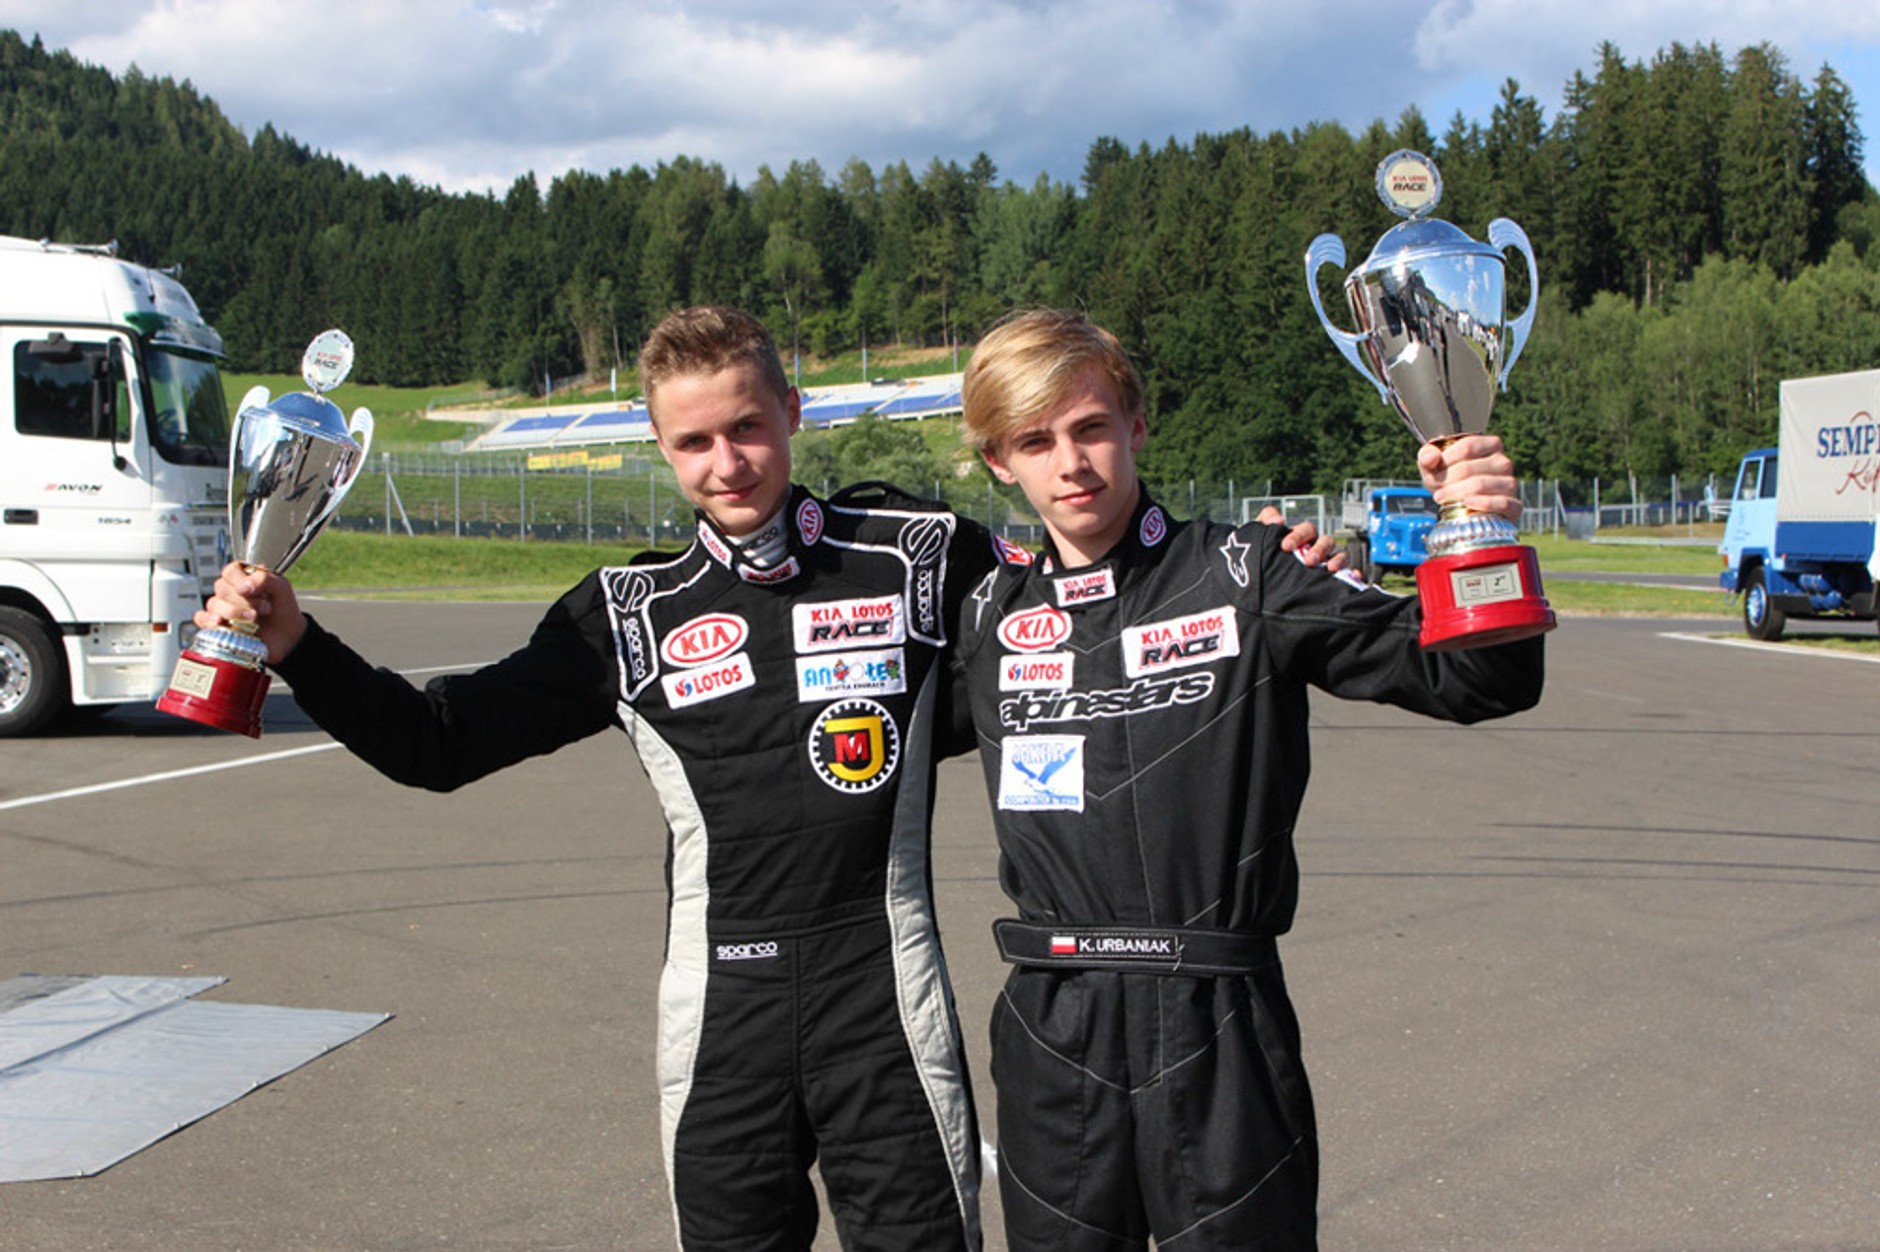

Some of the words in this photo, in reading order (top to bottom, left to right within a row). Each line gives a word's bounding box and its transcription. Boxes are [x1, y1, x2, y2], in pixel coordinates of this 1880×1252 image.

[1393, 183, 1427, 191] RACE
[1064, 585, 1106, 601] RACE
[811, 608, 843, 622] KIA
[852, 602, 893, 618] LOTOS
[809, 620, 892, 643] RACE
[1016, 616, 1055, 639] KIA
[1141, 629, 1172, 645] KIA
[1181, 616, 1224, 637] LOTOS
[680, 625, 732, 657] KIA
[1141, 634, 1221, 667] RACE
[693, 664, 743, 694] LOTOS
[1022, 663, 1063, 681] LOTOS
[999, 672, 1215, 732] alpinestars
